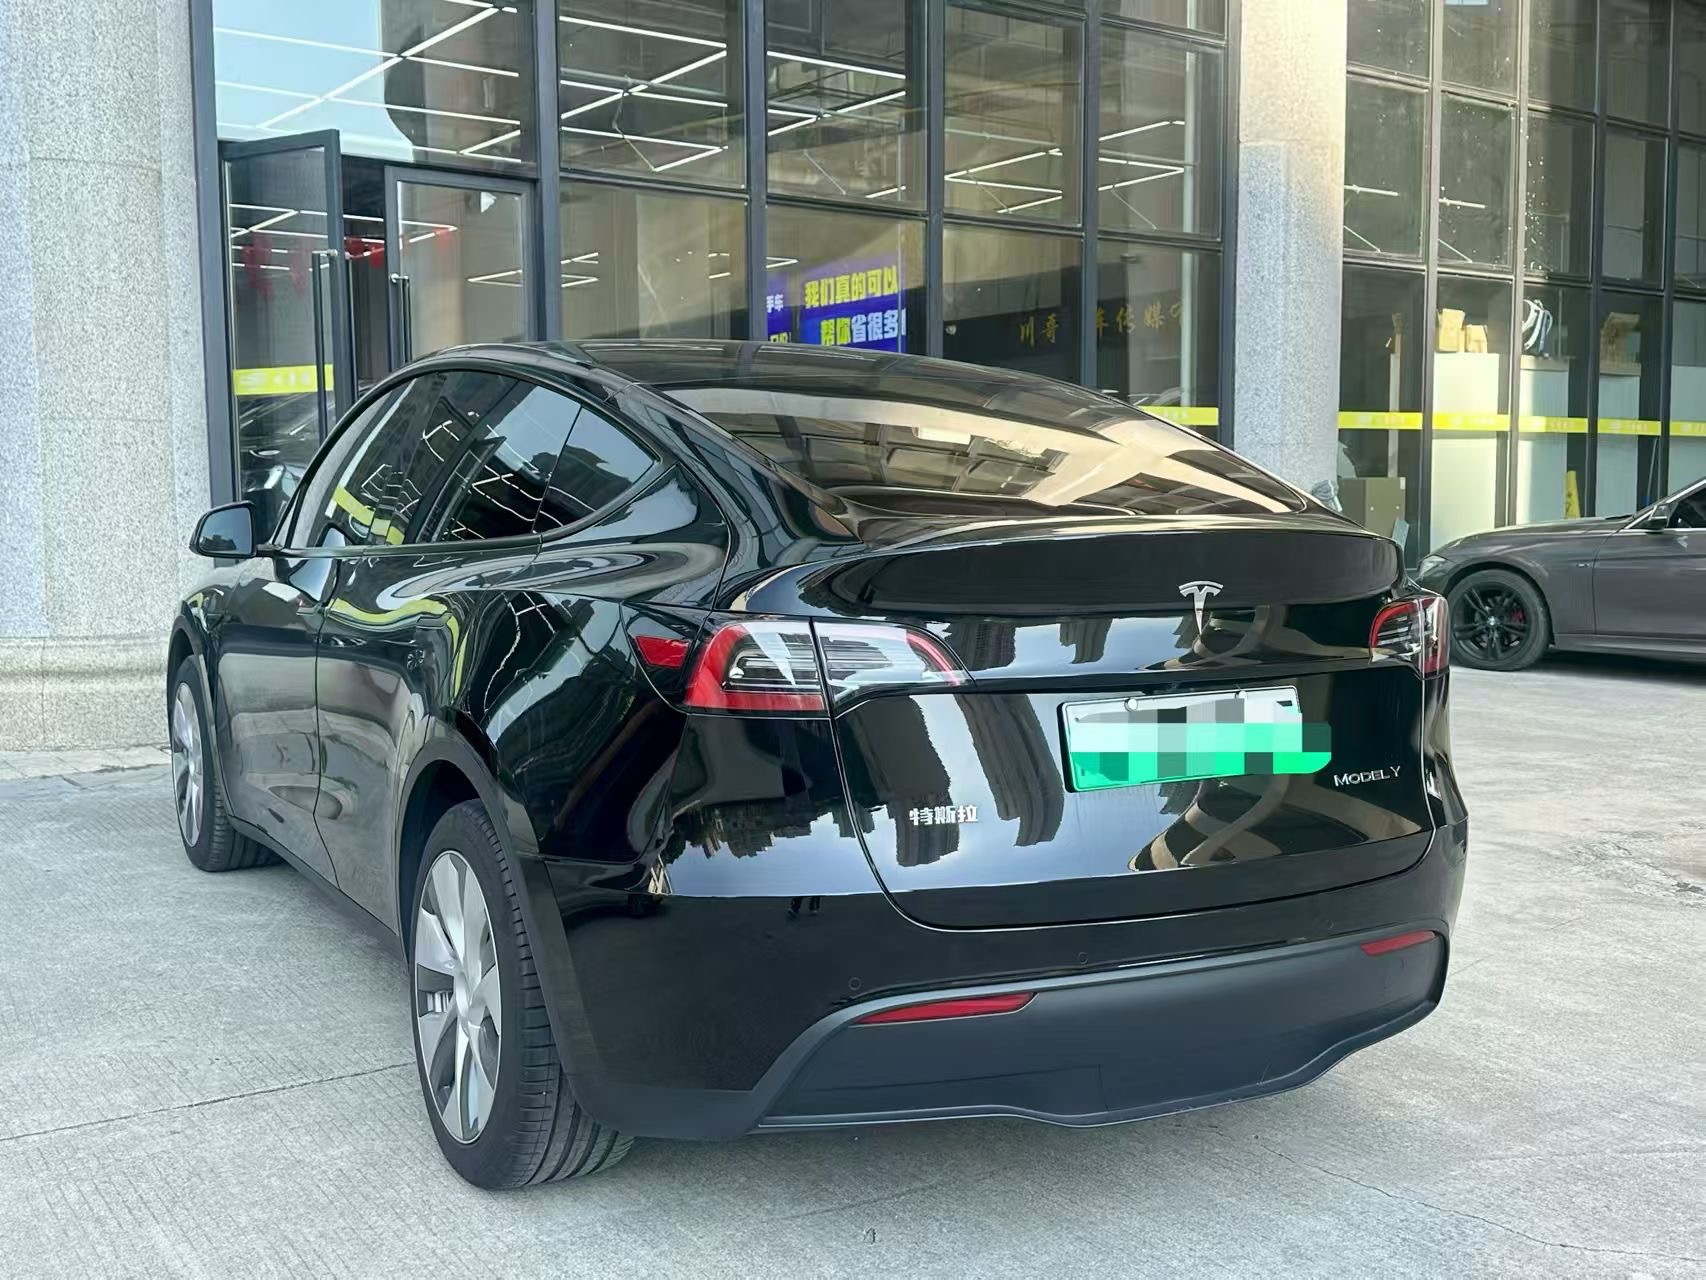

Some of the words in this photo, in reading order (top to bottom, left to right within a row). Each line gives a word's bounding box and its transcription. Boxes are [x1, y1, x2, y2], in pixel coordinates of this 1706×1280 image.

[805, 265, 898, 309] 我们真的可以
[821, 308, 906, 346] 帮你省很多
[1333, 769, 1391, 787] MODEL
[1389, 765, 1401, 777] Y
[909, 805, 979, 826] 特斯拉
